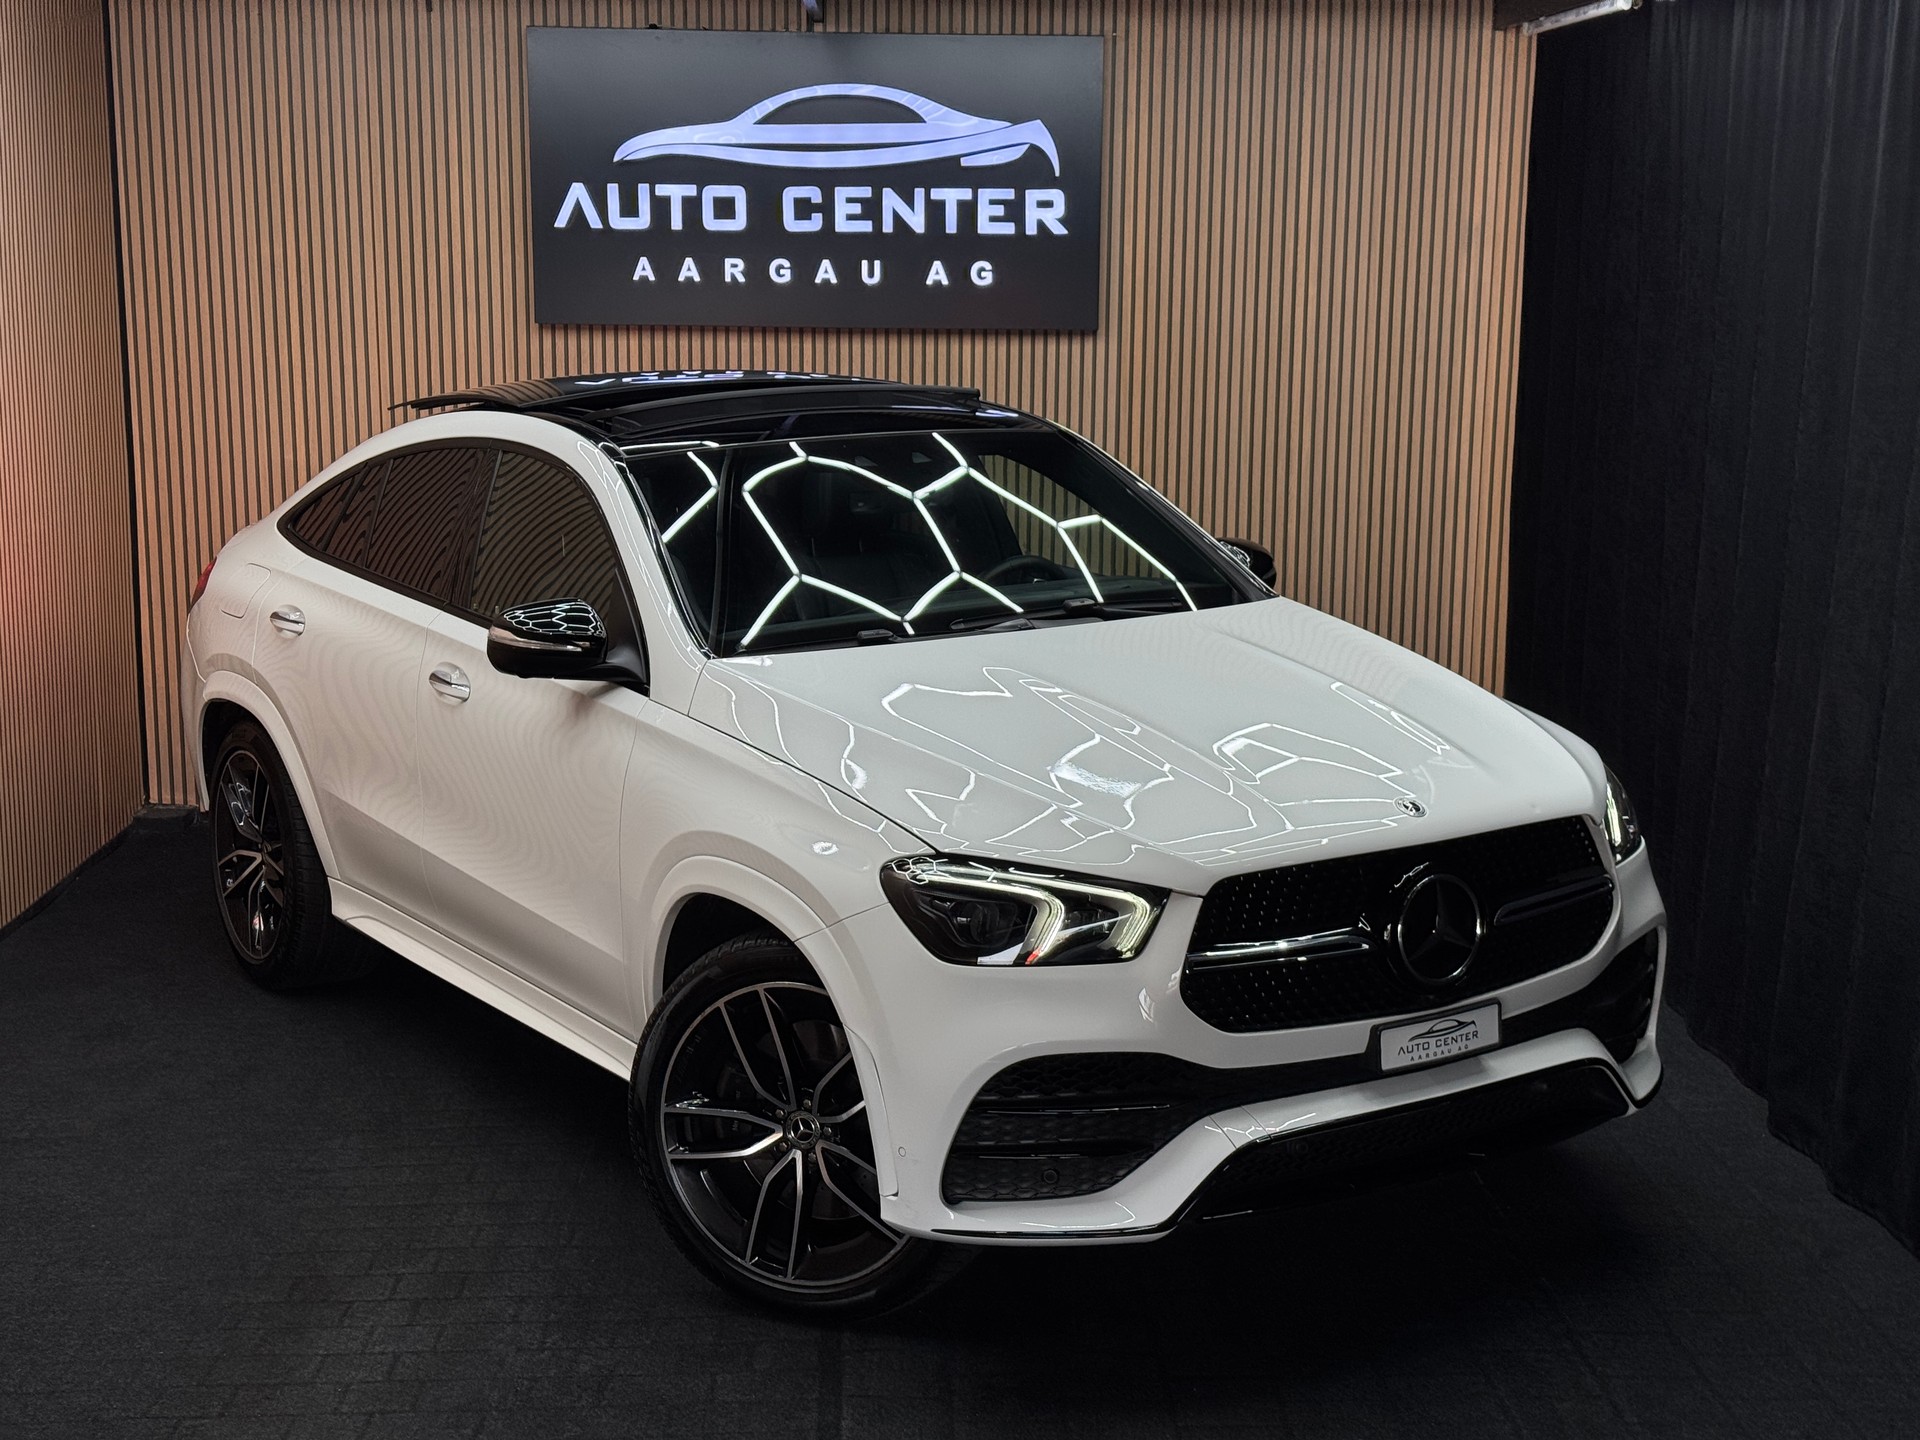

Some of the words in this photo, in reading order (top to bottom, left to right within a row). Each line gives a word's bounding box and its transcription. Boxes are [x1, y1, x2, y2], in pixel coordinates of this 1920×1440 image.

[553, 182, 747, 231] AUTO
[782, 186, 1069, 236] CENTER
[632, 256, 882, 286] AARGAU
[925, 260, 994, 287] AG
[1398, 1041, 1430, 1056] AUTO
[1435, 1030, 1479, 1048] CENTER
[1410, 1048, 1452, 1062] AARGAU
